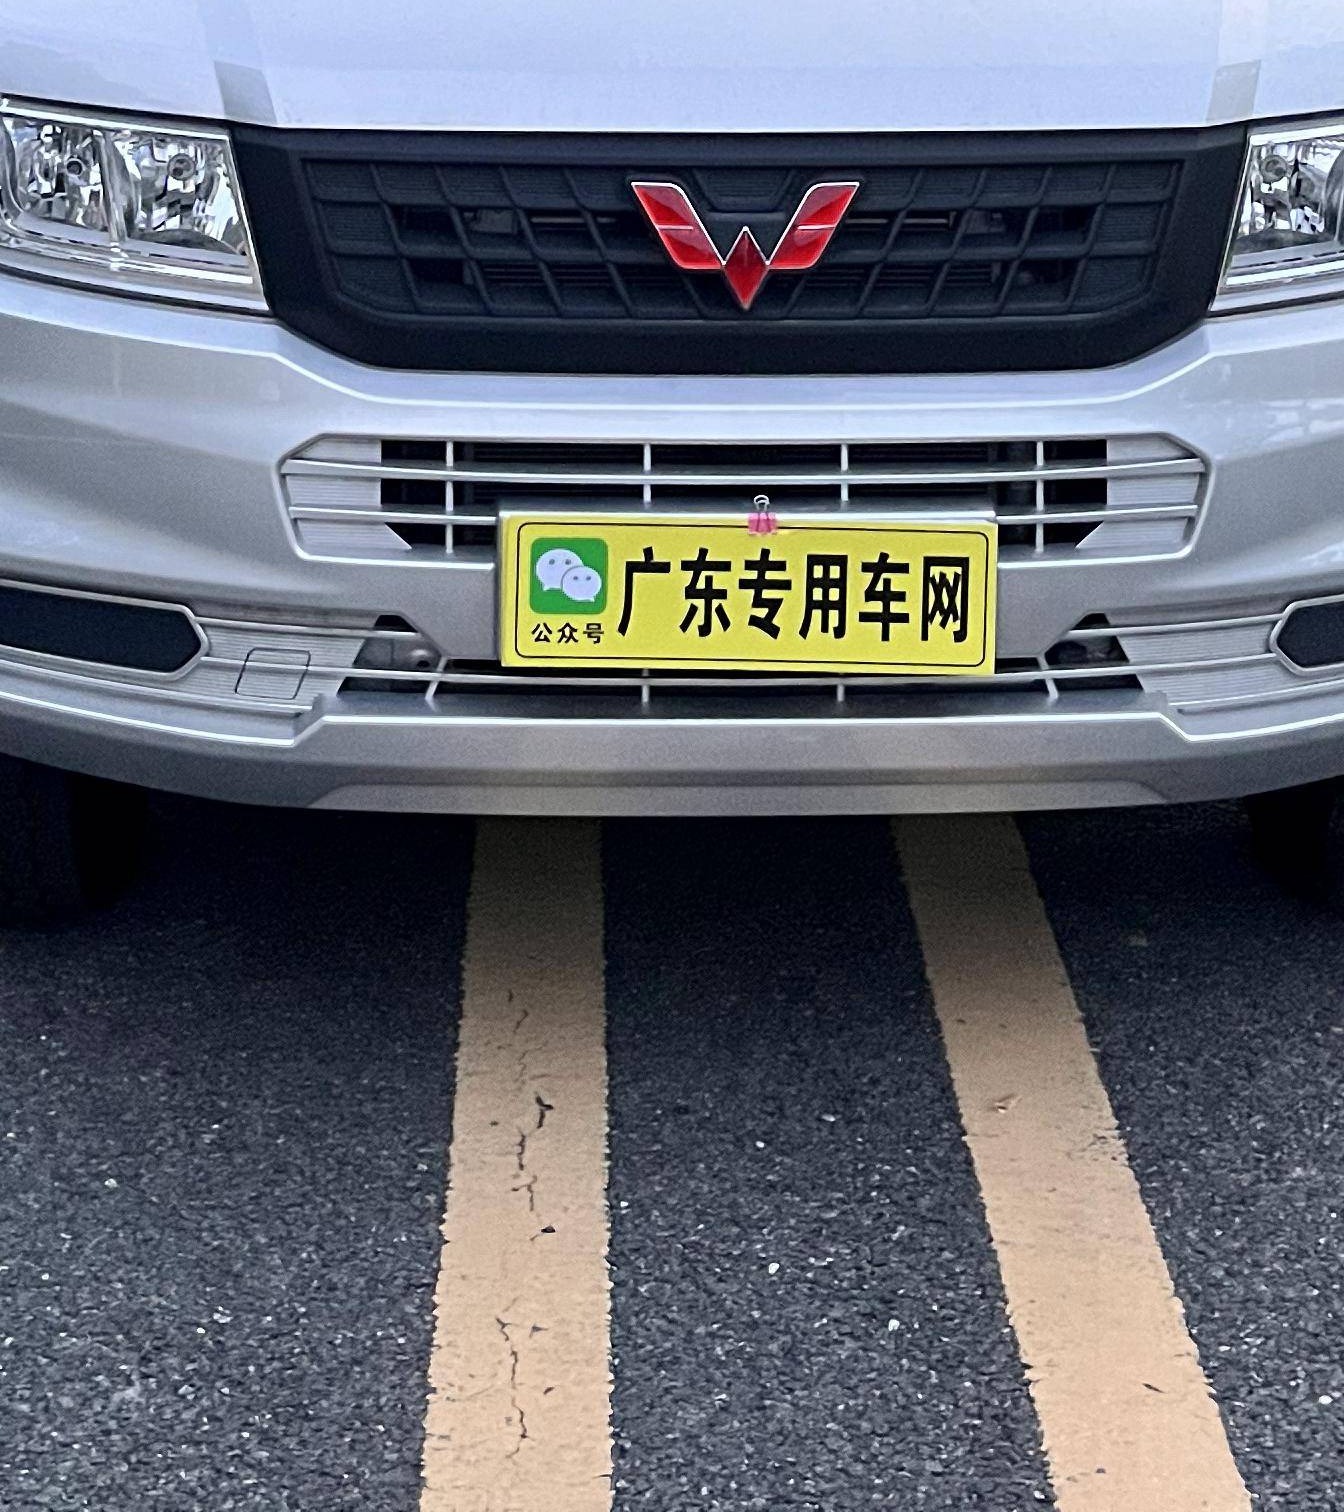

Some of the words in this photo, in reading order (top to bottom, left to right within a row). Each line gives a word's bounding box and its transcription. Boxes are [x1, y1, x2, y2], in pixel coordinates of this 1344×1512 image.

[616, 545, 970, 644] 广东专用车网
[531, 621, 605, 645] 公众号
